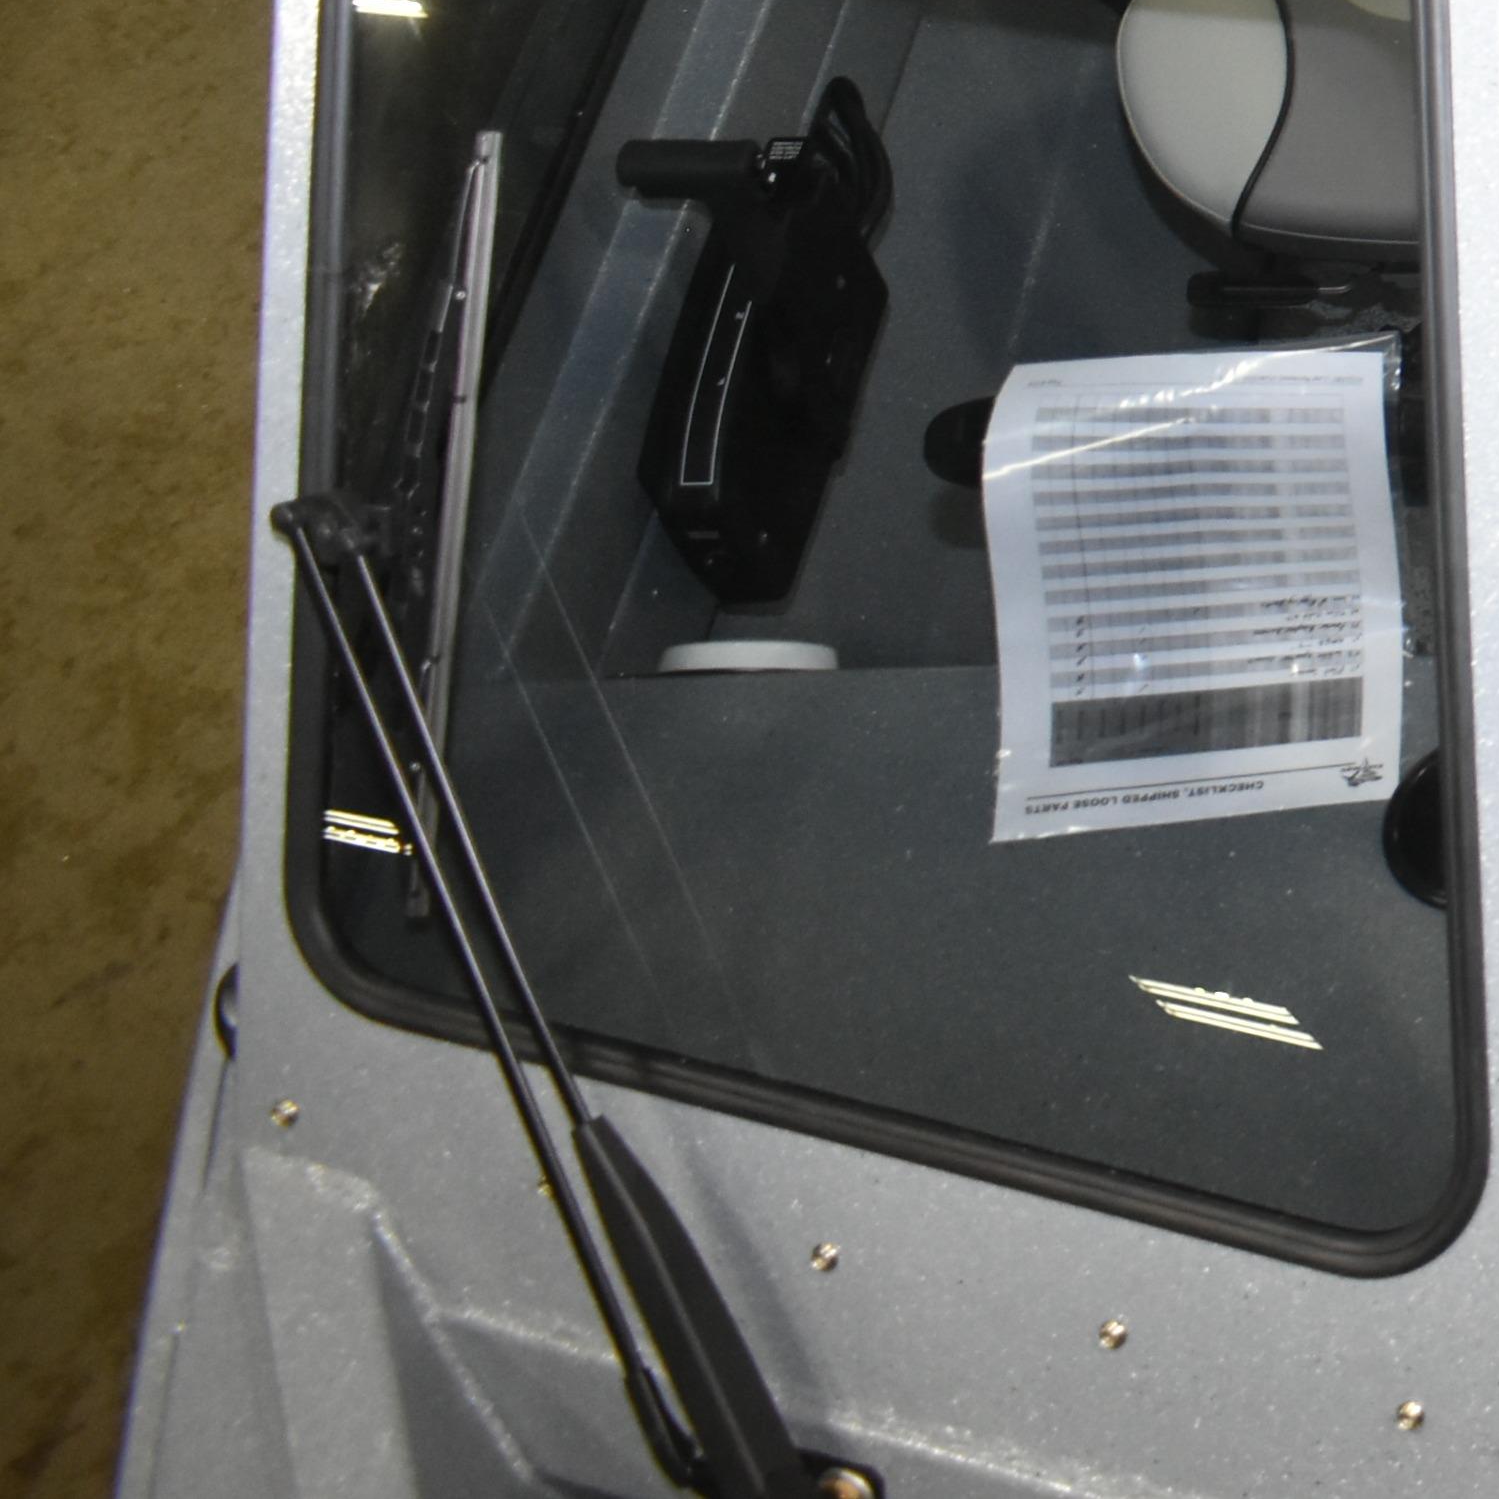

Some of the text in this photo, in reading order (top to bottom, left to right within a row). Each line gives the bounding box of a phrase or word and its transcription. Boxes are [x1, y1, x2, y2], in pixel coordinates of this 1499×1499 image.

[1024, 780, 1265, 815] CHECKLIST, SHIPPED LOOSE PARTS
